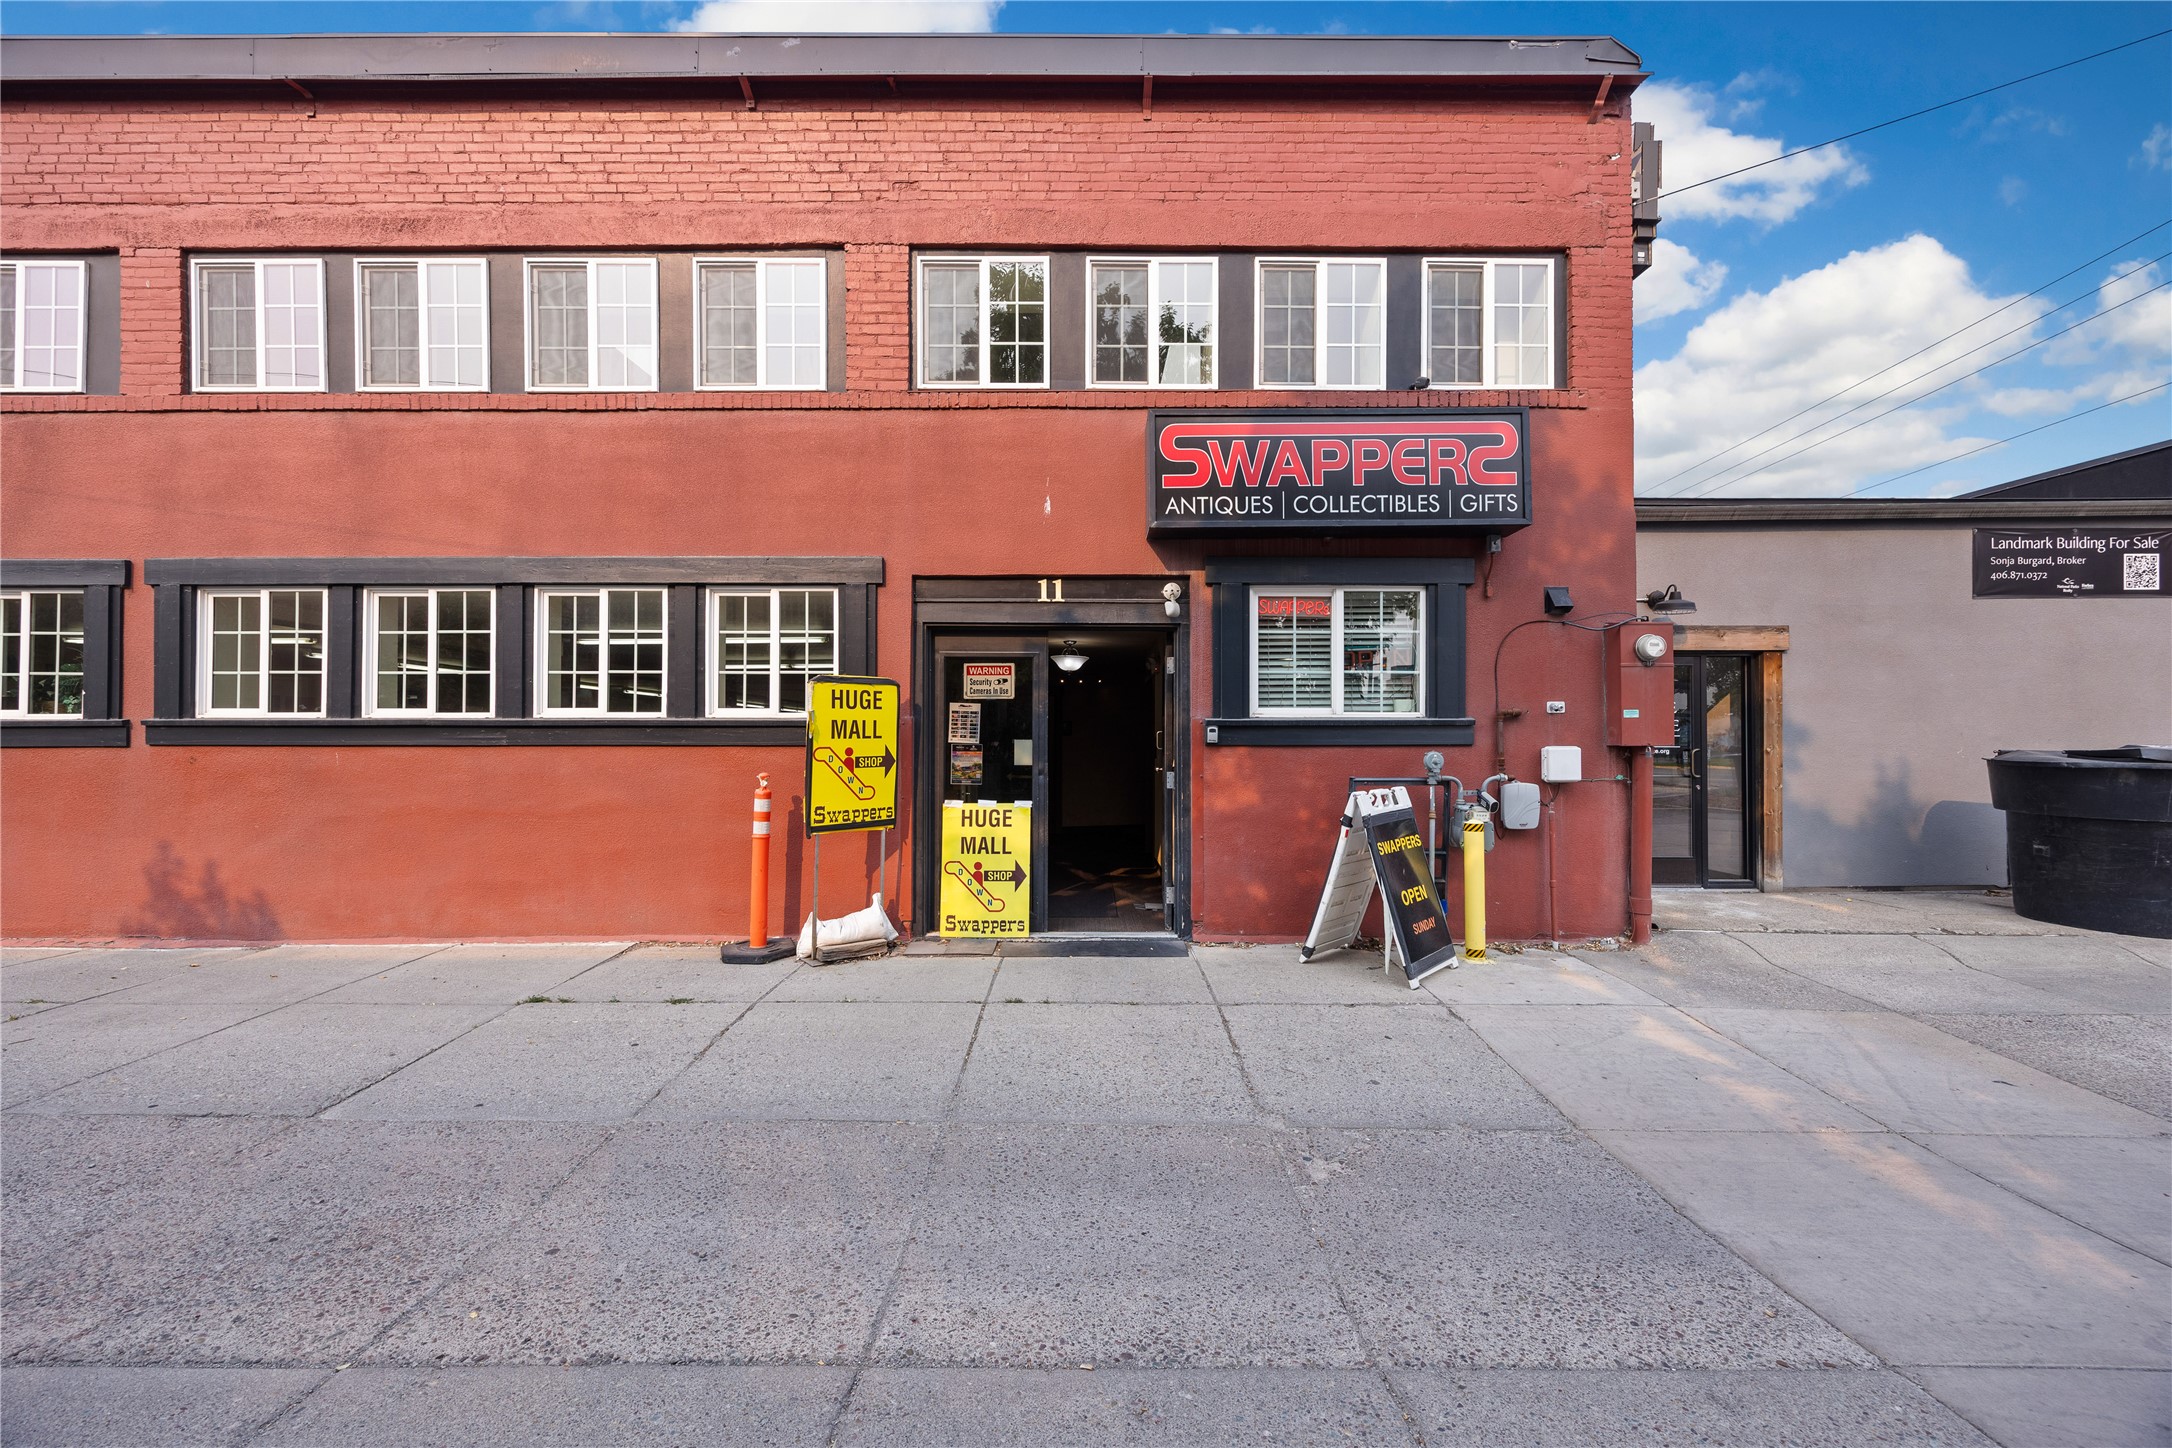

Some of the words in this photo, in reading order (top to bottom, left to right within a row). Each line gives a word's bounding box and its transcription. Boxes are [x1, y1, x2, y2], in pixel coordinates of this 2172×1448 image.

[1159, 421, 1519, 489] SWAPPERS
[1165, 495, 1273, 516] ANTIQUES
[1293, 494, 1440, 515] COLLECTIBLES
[1460, 493, 1518, 513] GIFTS
[1990, 537, 2053, 550] Landmark
[2056, 537, 2106, 553] Building
[2109, 537, 2130, 549] For
[2133, 536, 2159, 549] Sale
[1990, 556, 2015, 567] Sonja
[2017, 556, 2055, 567] Burgard,
[2057, 556, 2087, 565] Broker
[1990, 571, 2048, 580] 406.871.0372
[1037, 578, 1065, 602] 11
[968, 666, 1010, 675] WARNING
[969, 678, 992, 687] Security
[969, 687, 992, 695] Cameras
[831, 689, 883, 710] HUGE
[830, 719, 883, 740] MALL
[858, 756, 883, 768] SHOP
[813, 805, 893, 824] Swappers
[961, 809, 1013, 828] HUGE
[960, 836, 1012, 855] MALL
[1376, 834, 1423, 856] SWAPPERS
[987, 871, 1013, 881] SHOP
[1400, 884, 1428, 906] OPEN
[945, 915, 1025, 934] Swappers
[1412, 916, 1435, 935] SUNDAY
